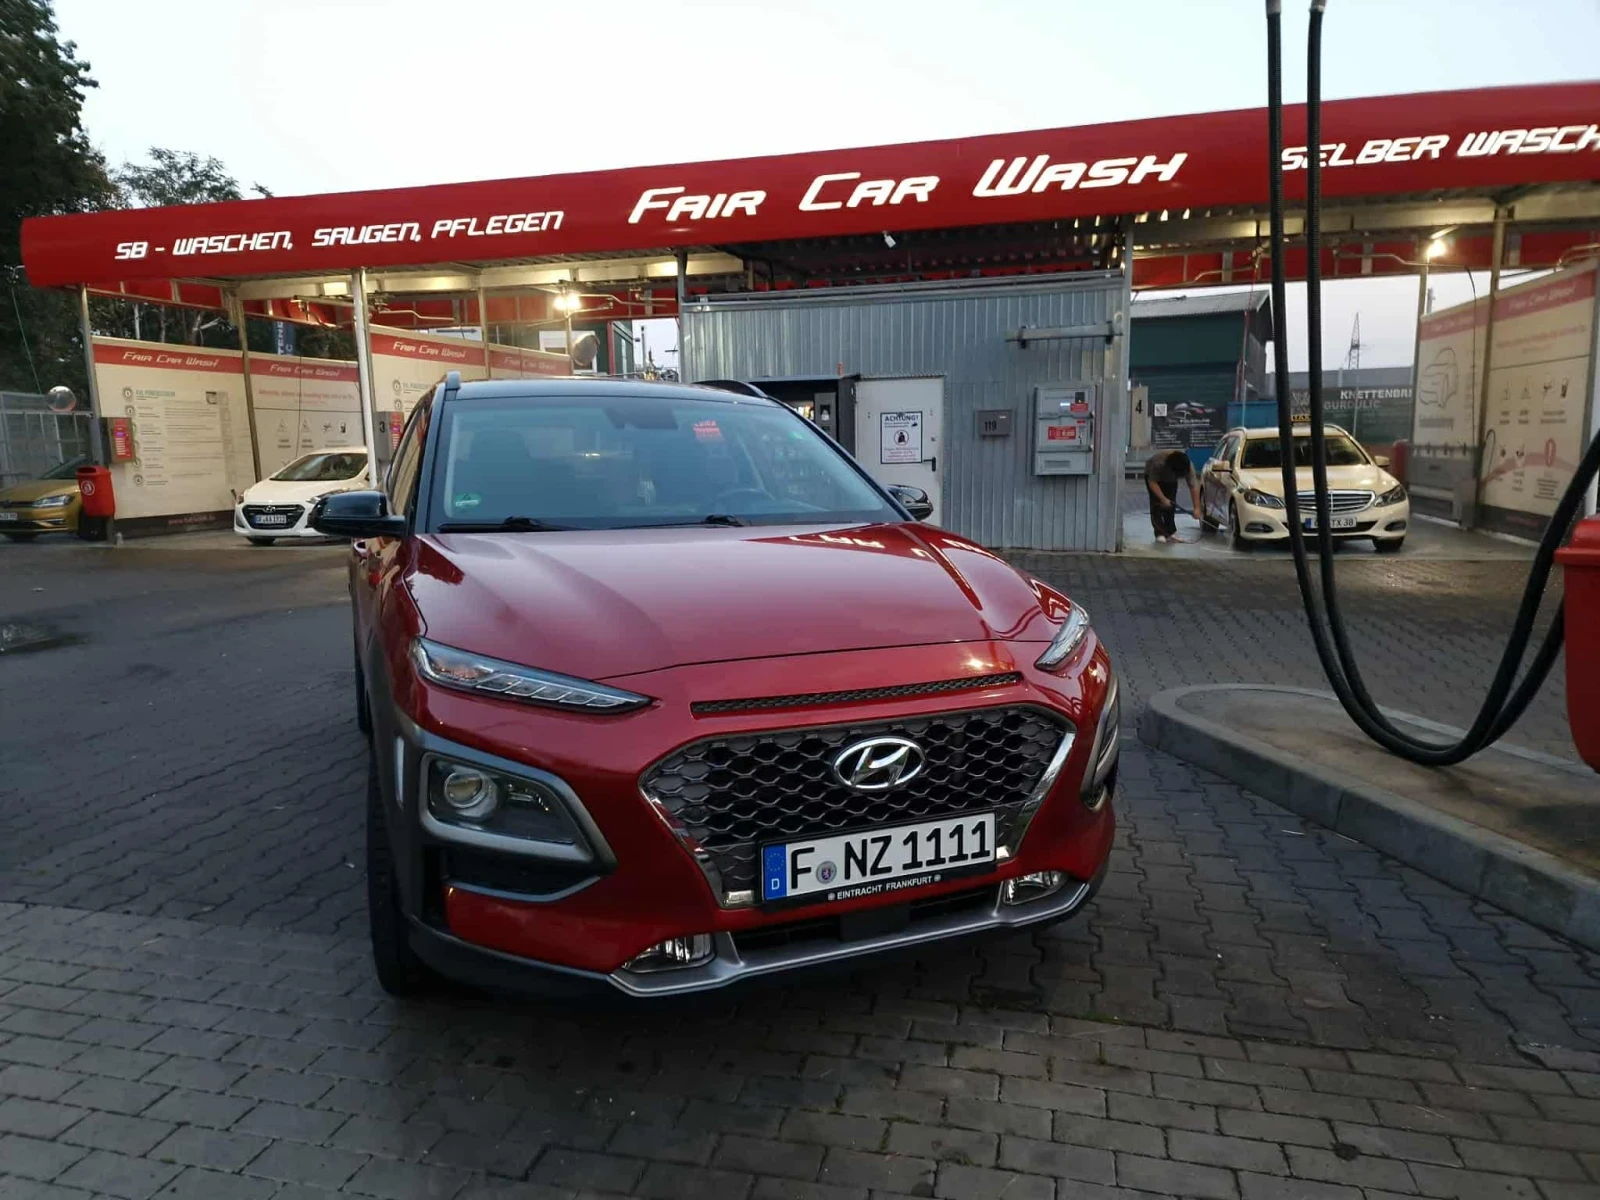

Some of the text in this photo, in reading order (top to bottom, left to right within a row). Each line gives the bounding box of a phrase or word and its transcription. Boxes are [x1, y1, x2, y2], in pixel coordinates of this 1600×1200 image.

[1281, 135, 1450, 171] SELBER
[628, 153, 1188, 224] FAIR CAR WASH
[115, 242, 149, 260] SB
[172, 231, 294, 255] WASCHEN,
[311, 222, 422, 246] SAUGEN,
[431, 211, 565, 238] PFLEGEN
[393, 341, 417, 352] FAIR
[419, 344, 439, 355] CAR
[122, 351, 219, 368] FAIR CAR WASH
[1135, 399, 1143, 414] 4
[885, 414, 919, 422] ACHTUNG!
[790, 820, 991, 890] F NZ 1111
[771, 879, 780, 891] D
[837, 876, 932, 900] EINTRACHT FRANKFURT
